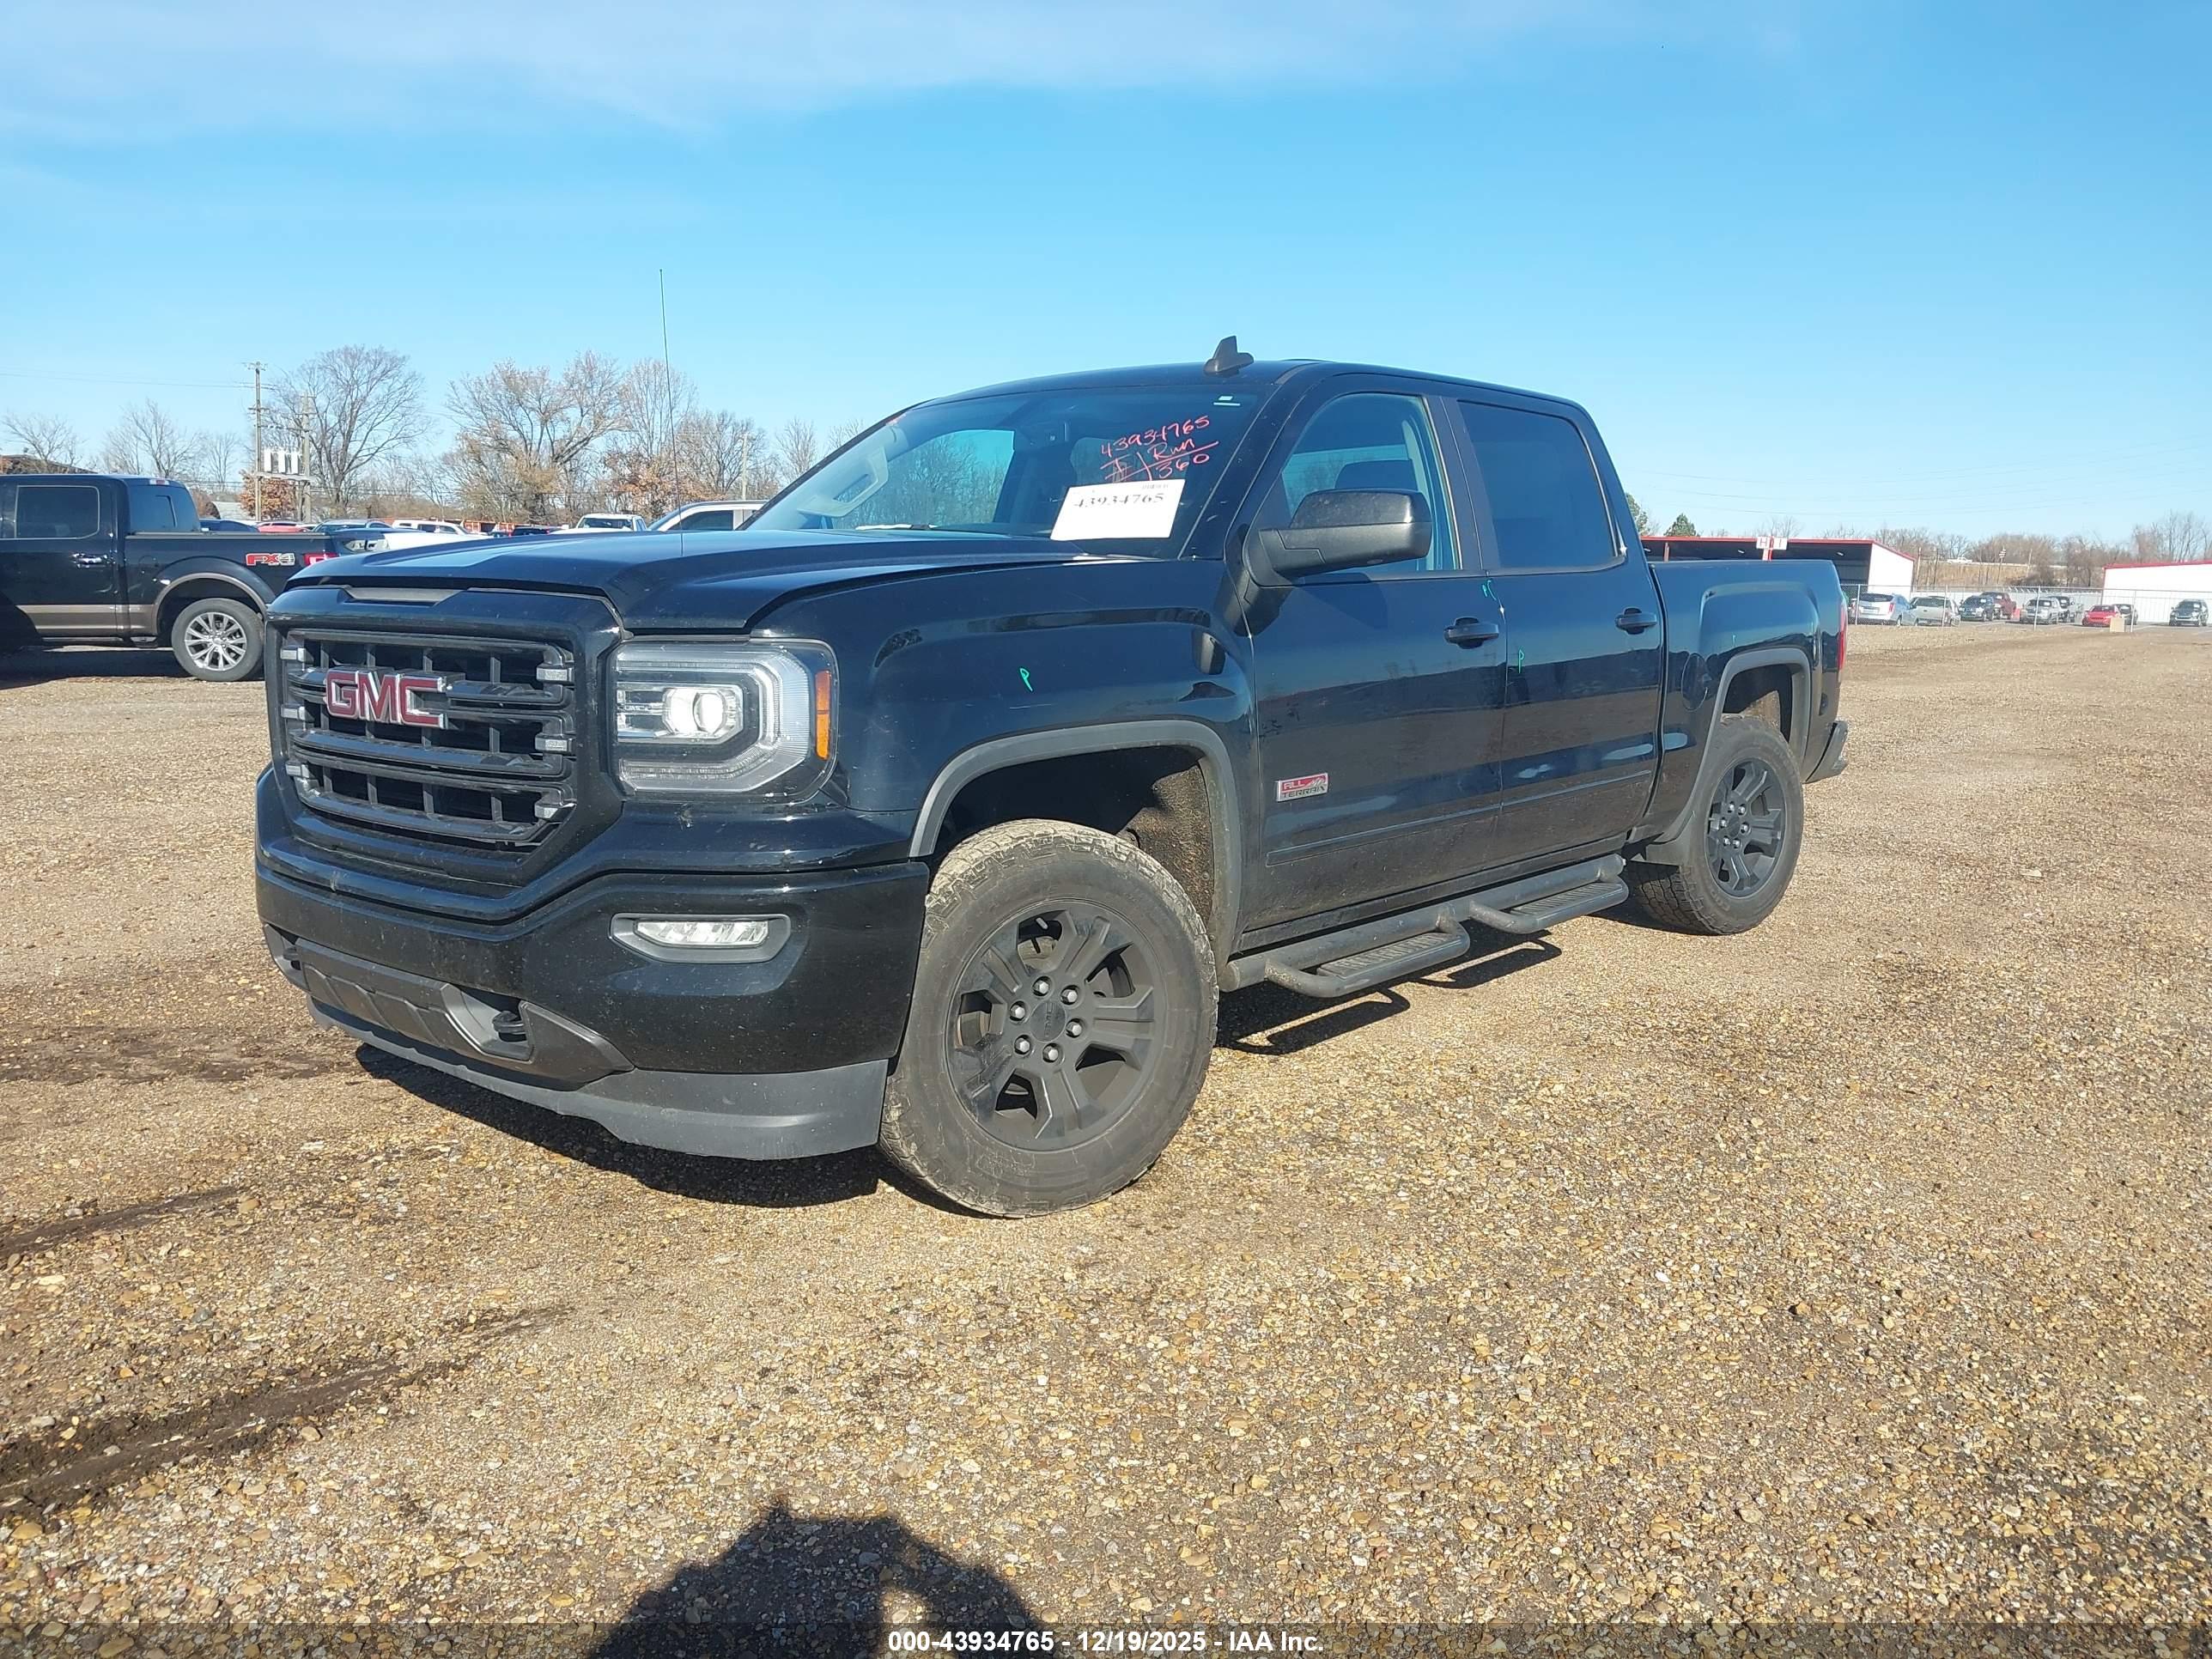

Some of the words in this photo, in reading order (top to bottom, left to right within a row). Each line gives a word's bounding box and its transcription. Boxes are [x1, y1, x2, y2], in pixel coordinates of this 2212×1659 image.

[1101, 415, 1210, 458] 43934765
[1146, 441, 1195, 460] Run
[1155, 453, 1210, 479] 360
[1073, 493, 1164, 507] 43934765
[246, 553, 295, 567] FX4
[326, 668, 447, 729] GMC
[1283, 780, 1305, 790] ALL
